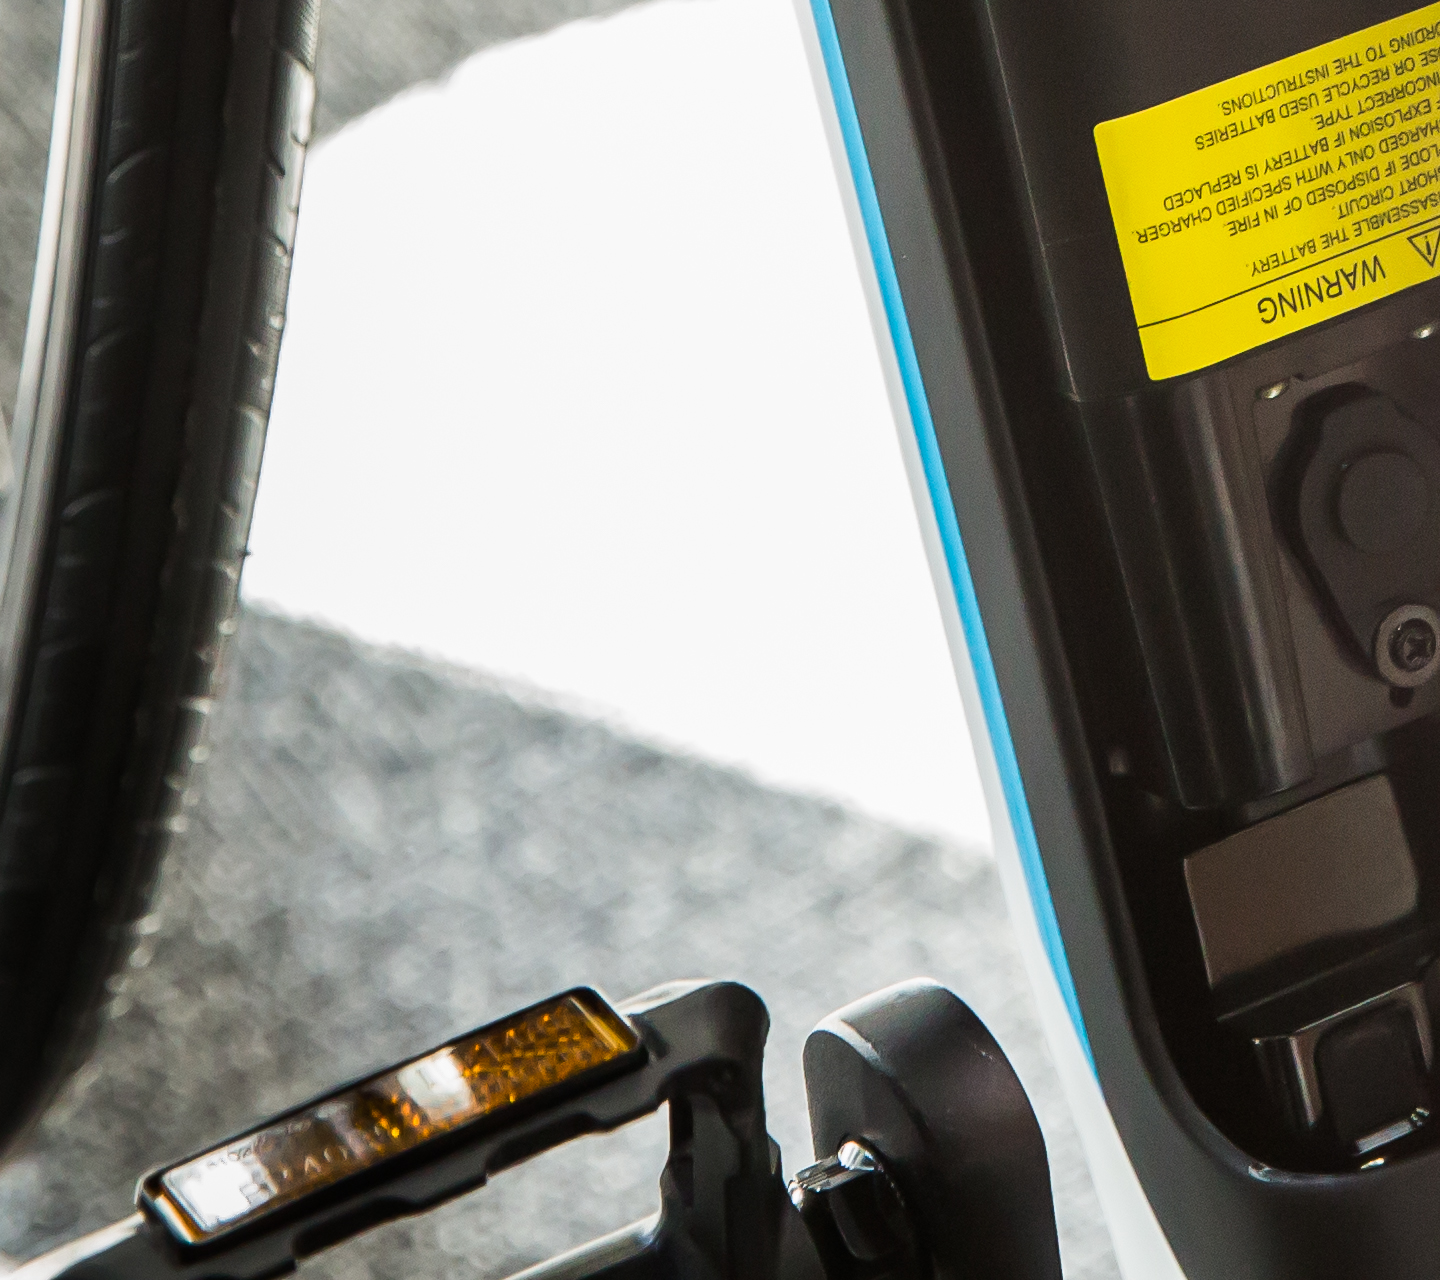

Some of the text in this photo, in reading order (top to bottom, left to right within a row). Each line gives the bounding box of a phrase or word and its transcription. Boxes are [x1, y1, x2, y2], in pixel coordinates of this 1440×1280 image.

[1331, 51, 1363, 75] THE
[1364, 42, 1387, 62] TO
[1392, 56, 1416, 76] OR
[1217, 63, 1329, 116] INSTRUCTIONS.
[1321, 65, 1390, 103] RECYCLE
[1357, 71, 1440, 115] INCORRECT
[1278, 92, 1319, 119] USED
[1194, 108, 1276, 150] BATTERIES
[1348, 98, 1432, 141] EXPLOSION
[1333, 130, 1346, 148] IF
[1263, 136, 1329, 174] BATTERY
[1336, 144, 1375, 171] ONLY
[1384, 159, 1397, 178] IF
[1244, 162, 1259, 181] IS
[1294, 160, 1334, 186] WITH
[1162, 169, 1242, 211] REPLACED
[1215, 175, 1292, 216] SPECIFIED
[1305, 165, 1380, 206] DISPOSED
[1262, 204, 1279, 223] IN
[1283, 195, 1302, 216] OF
[1318, 227, 1350, 250] THE
[1256, 255, 1386, 324] WARNING
